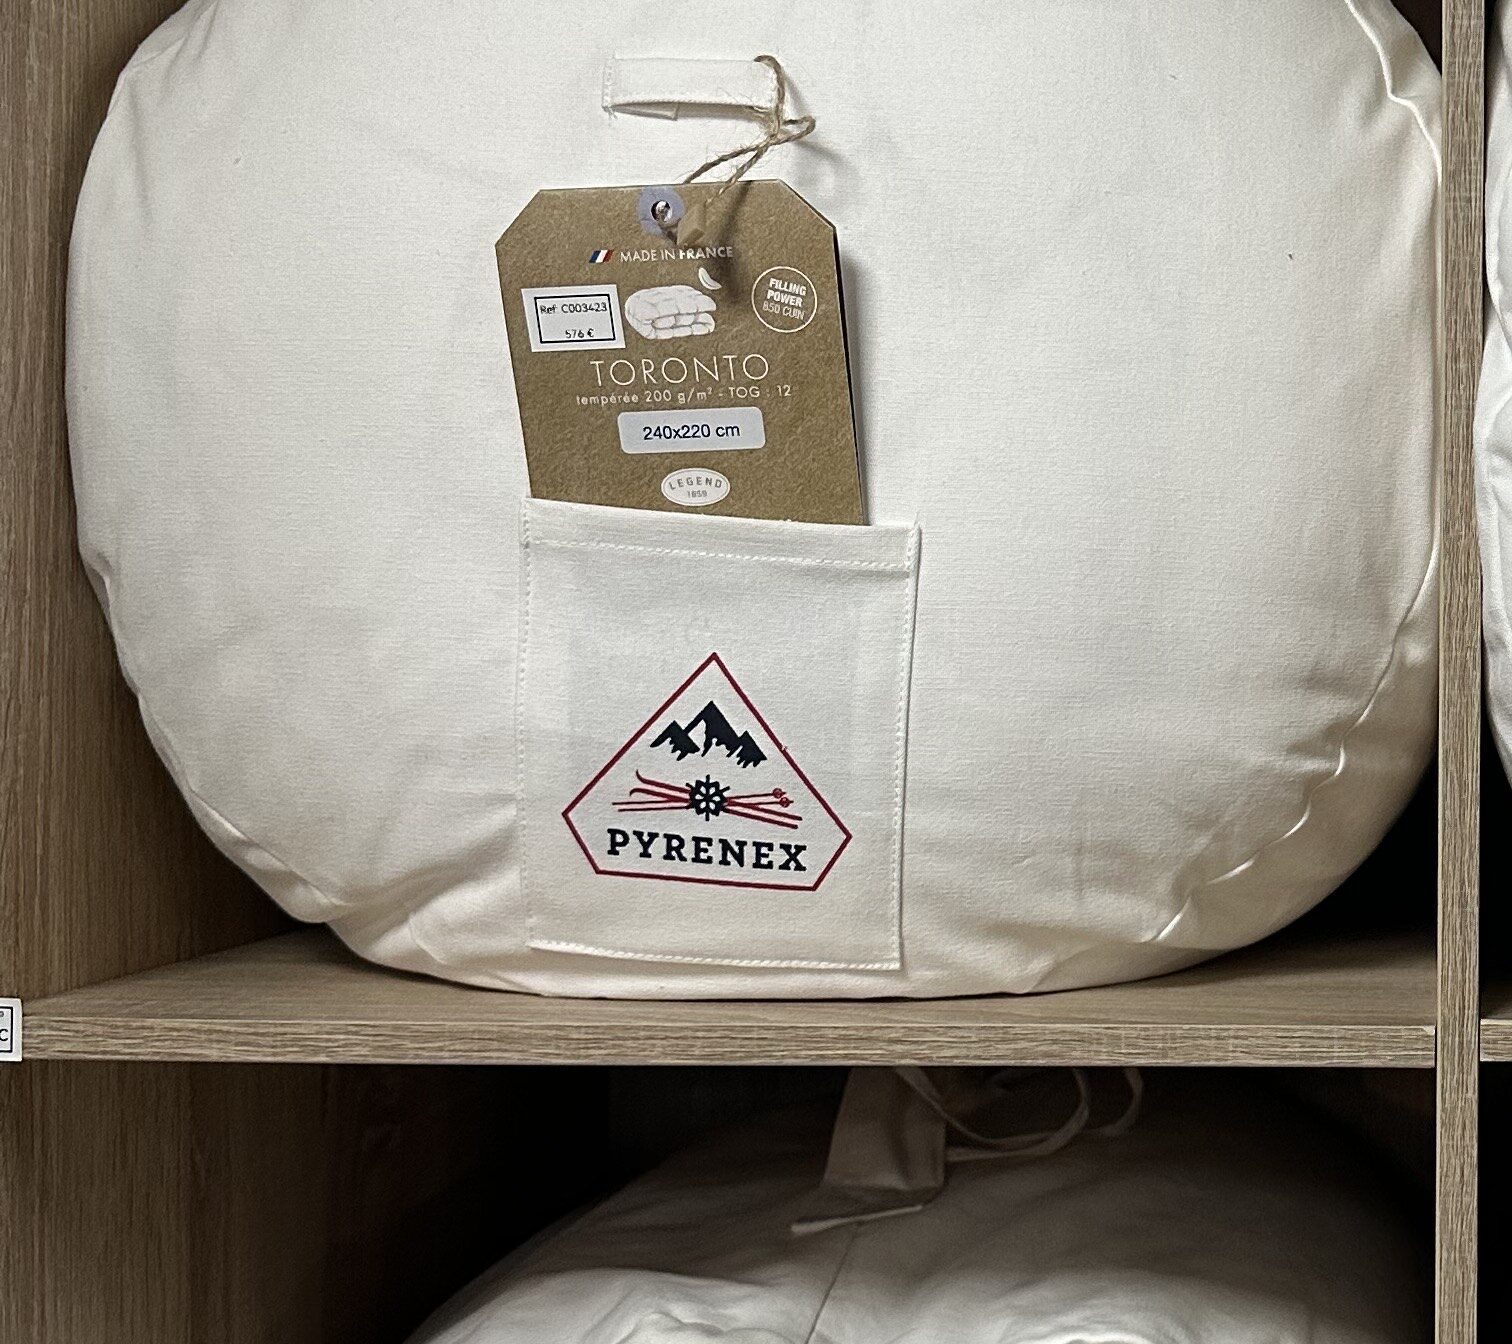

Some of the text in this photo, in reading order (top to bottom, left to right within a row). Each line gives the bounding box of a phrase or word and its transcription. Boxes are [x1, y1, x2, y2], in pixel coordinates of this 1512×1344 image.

[619, 246, 733, 262] MADE IN FRANCE
[769, 278, 807, 296] FILLING
[766, 290, 803, 307] POWER
[561, 302, 607, 313] C003423
[762, 300, 781, 314] 850
[587, 328, 595, 337] €
[590, 354, 769, 386] TORONTO
[576, 393, 639, 407] tempérée
[644, 390, 672, 402] 200
[729, 386, 760, 398] TOG
[776, 384, 792, 397] 12
[643, 424, 740, 440] 240x220 cm
[668, 476, 723, 491] LEGEND
[607, 828, 807, 872] PYRENEX
